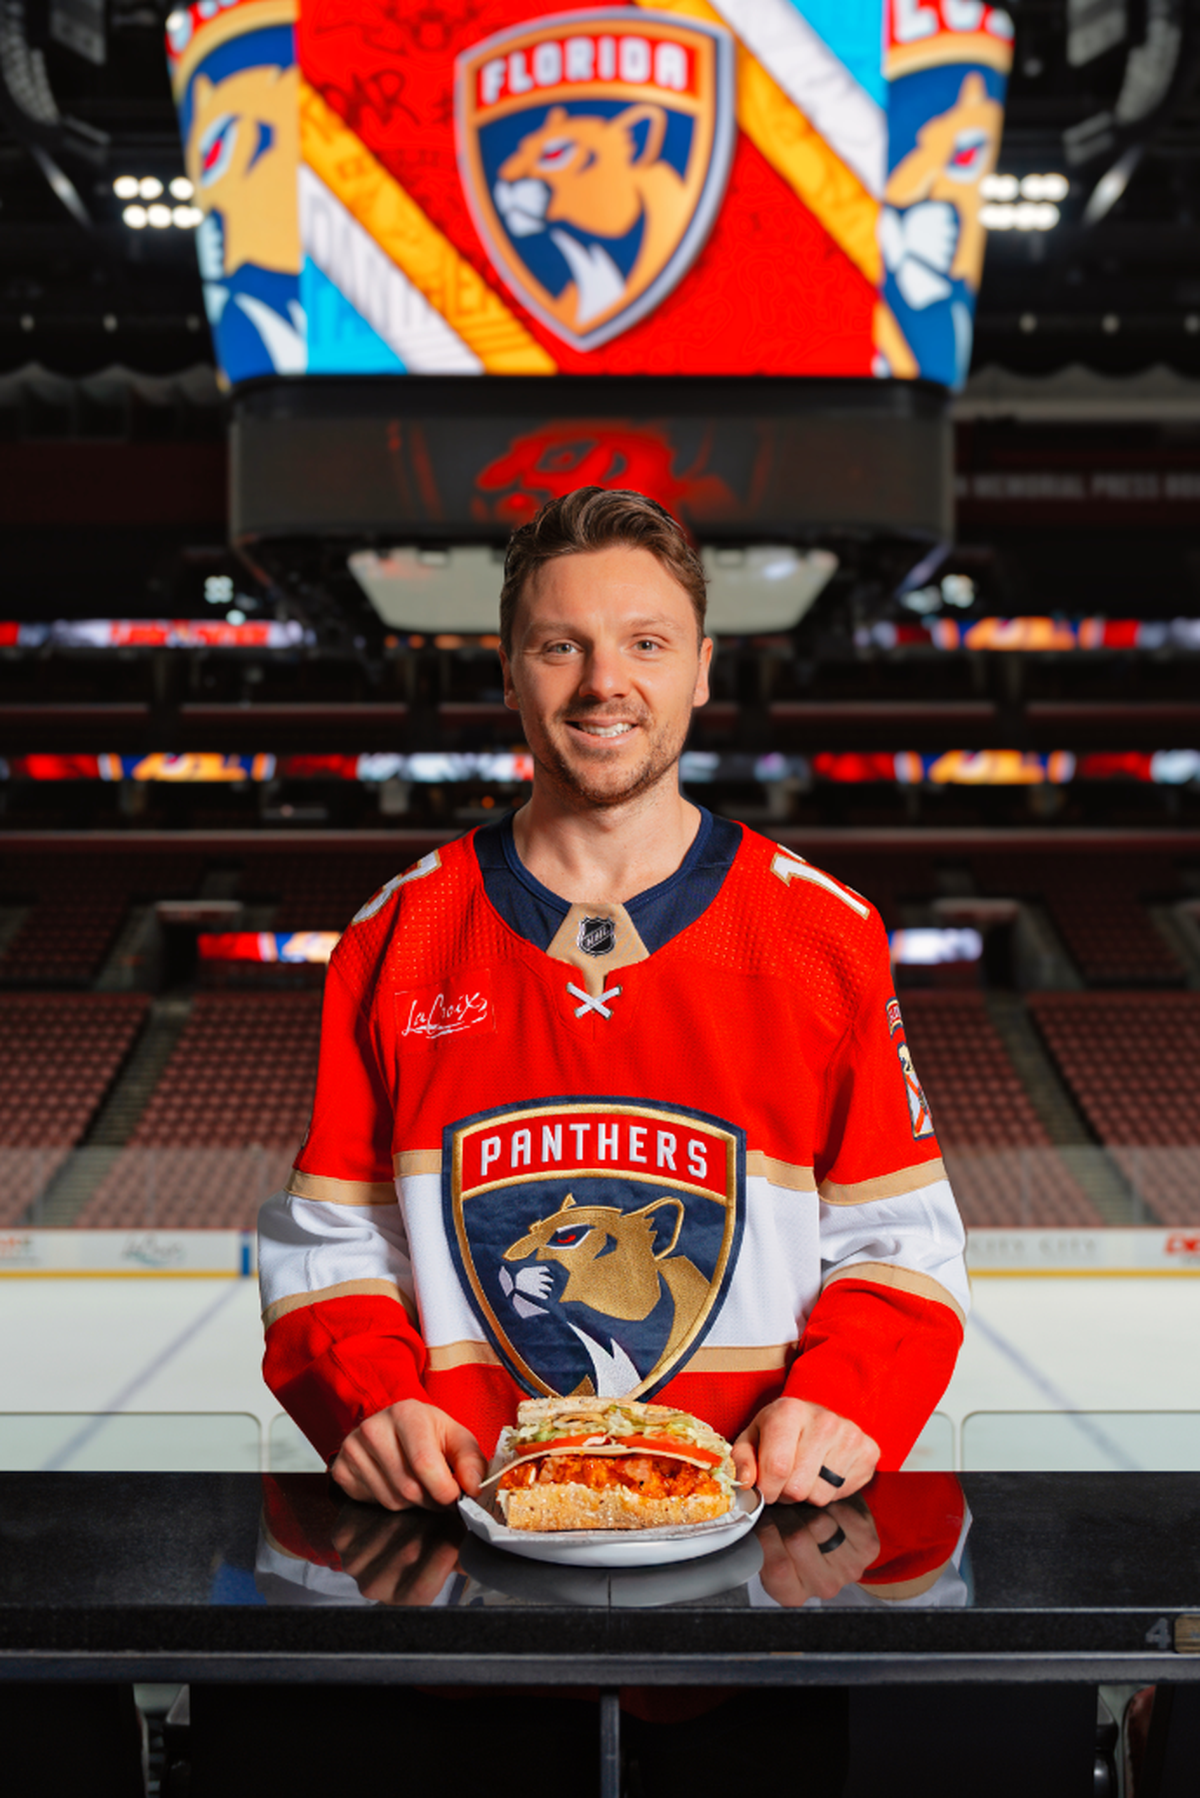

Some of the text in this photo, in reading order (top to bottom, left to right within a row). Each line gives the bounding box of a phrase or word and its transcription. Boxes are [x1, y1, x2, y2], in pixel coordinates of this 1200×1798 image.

[480, 36, 688, 105] FLORIDA
[586, 924, 610, 948] NHL
[401, 991, 488, 1039] LaCroix
[480, 1123, 708, 1179] PANTHERS
[1145, 1617, 1171, 1649] 4
